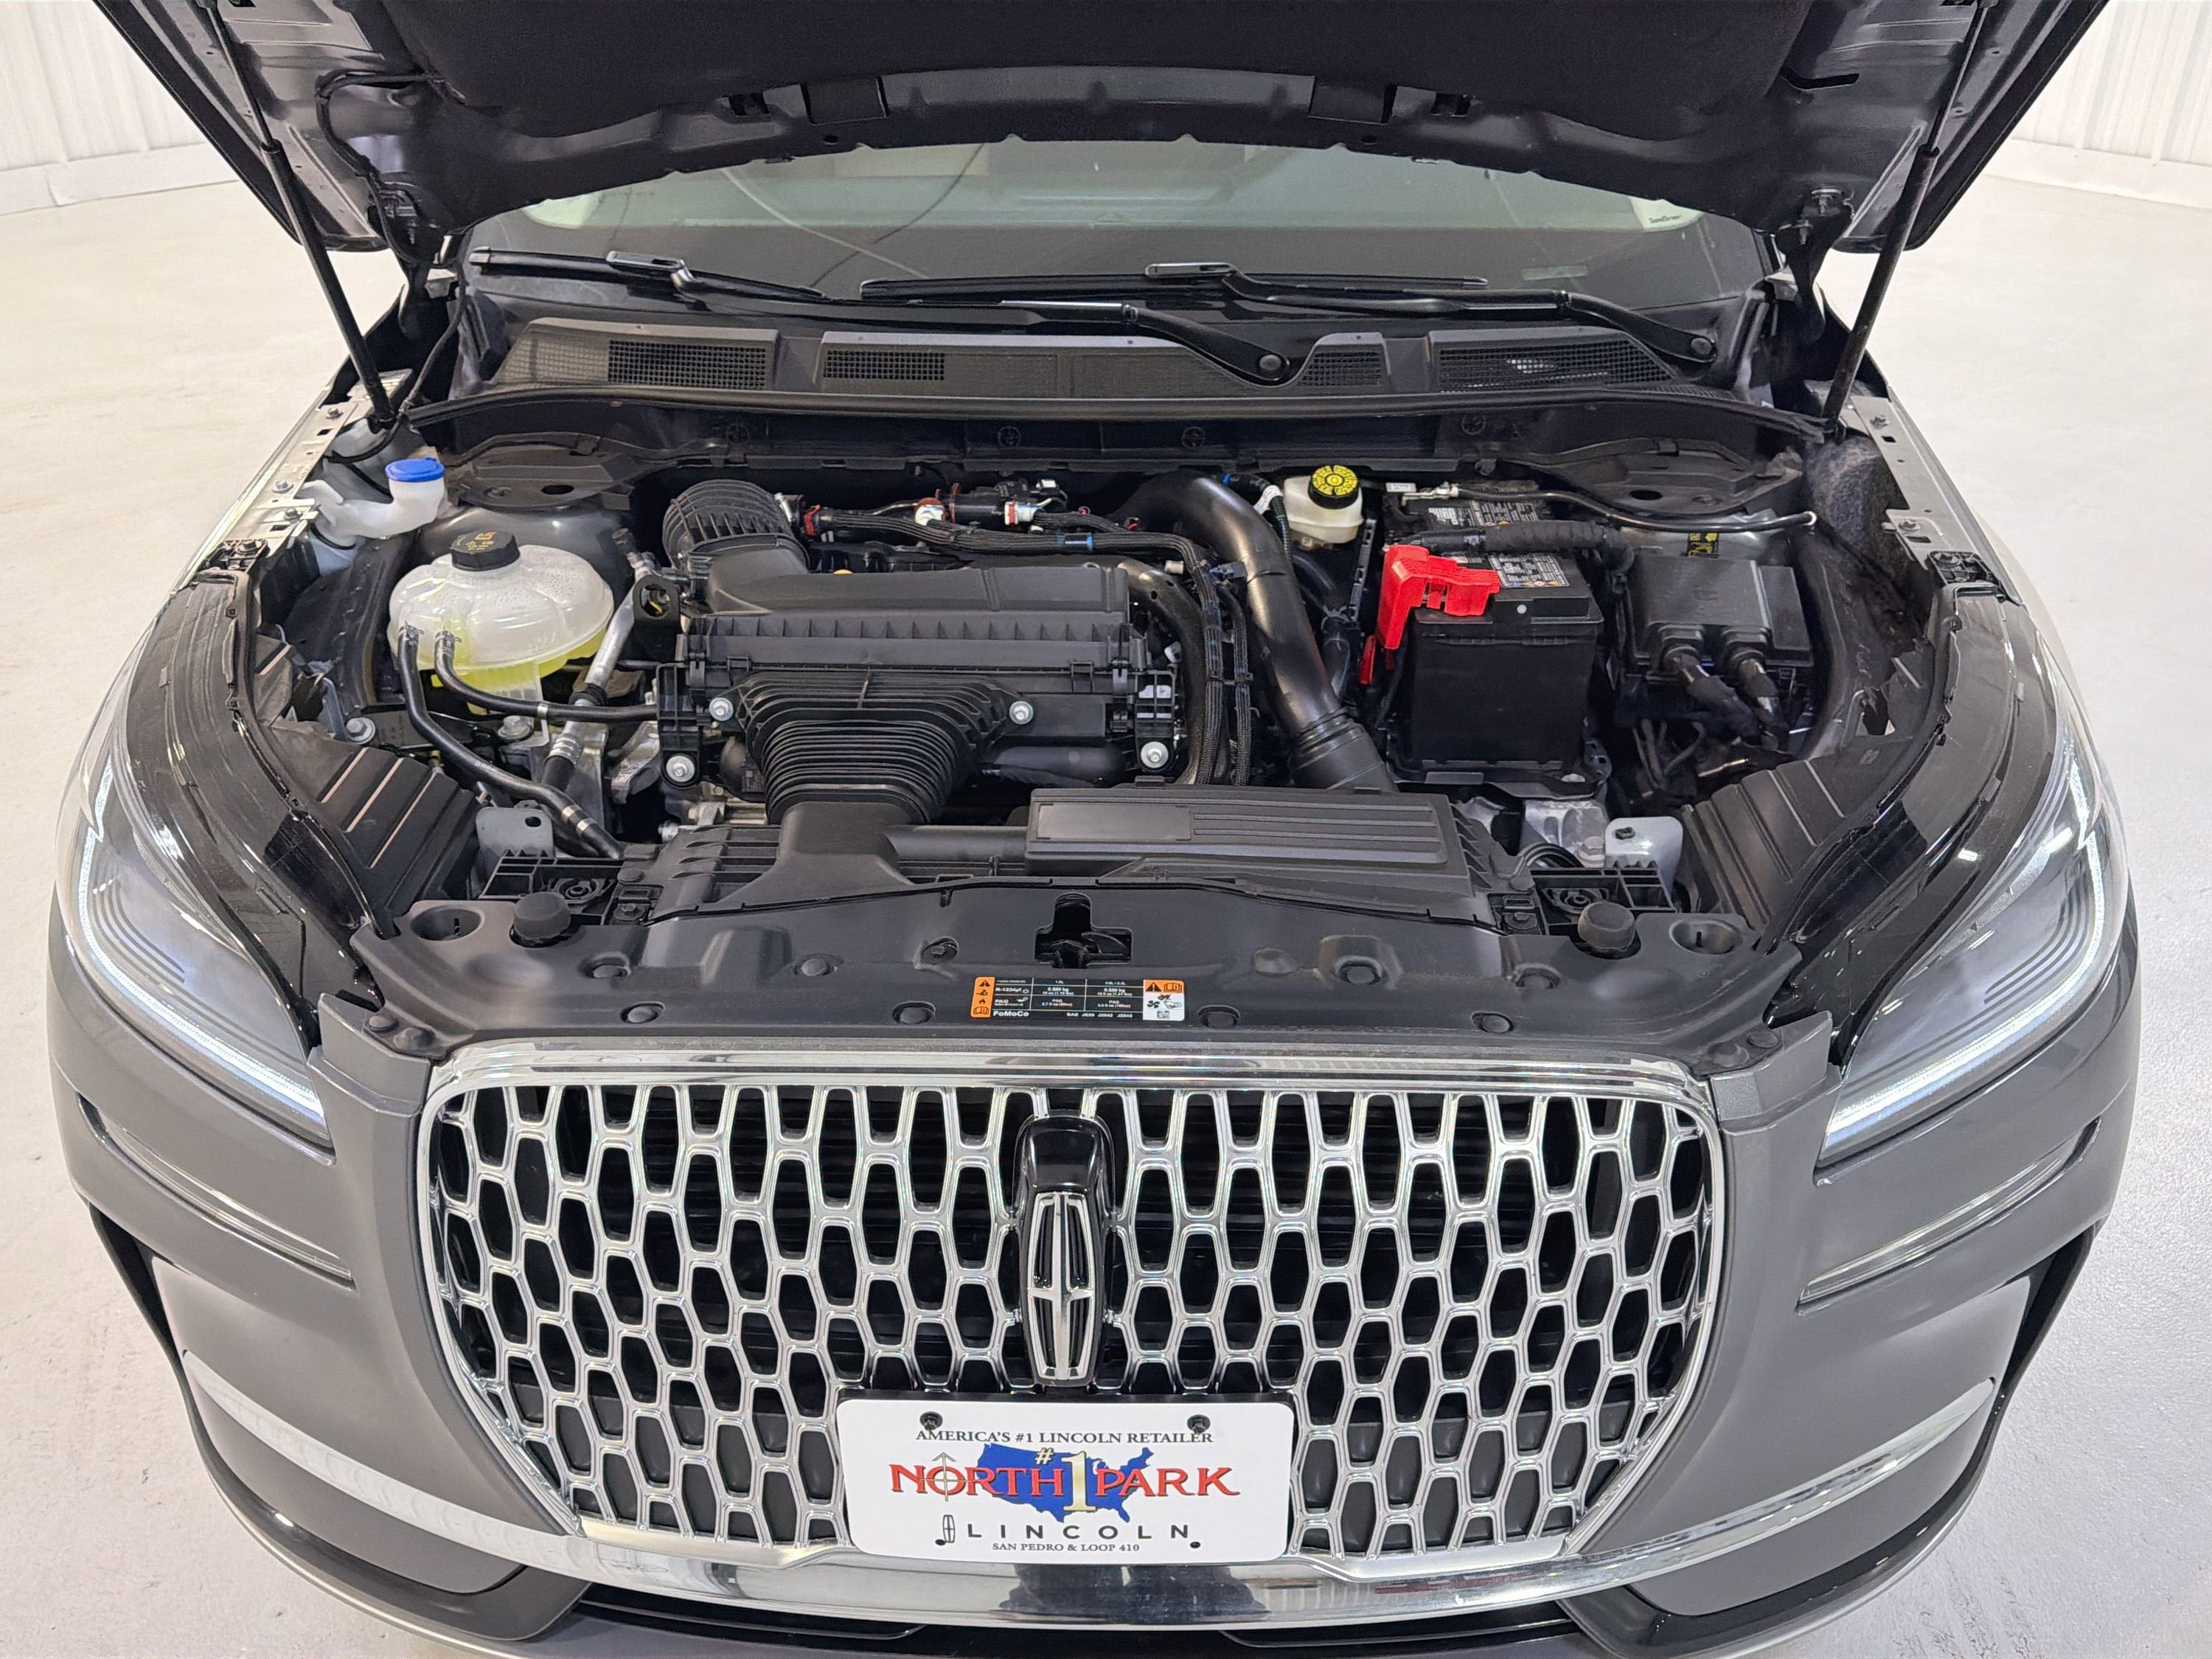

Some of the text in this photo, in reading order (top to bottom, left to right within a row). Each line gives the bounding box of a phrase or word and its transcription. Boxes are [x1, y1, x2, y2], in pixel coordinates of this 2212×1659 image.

[1015, 1433, 1034, 1443] #1
[1038, 1432, 1123, 1444] LINCOLN
[1126, 1432, 1214, 1444] RETAILER
[889, 1464, 1241, 1498] NORTH PARK
[967, 1523, 1189, 1540] LINCOLN
[992, 1543, 1018, 1551] SAN
[1020, 1543, 1064, 1551] PEDRO
